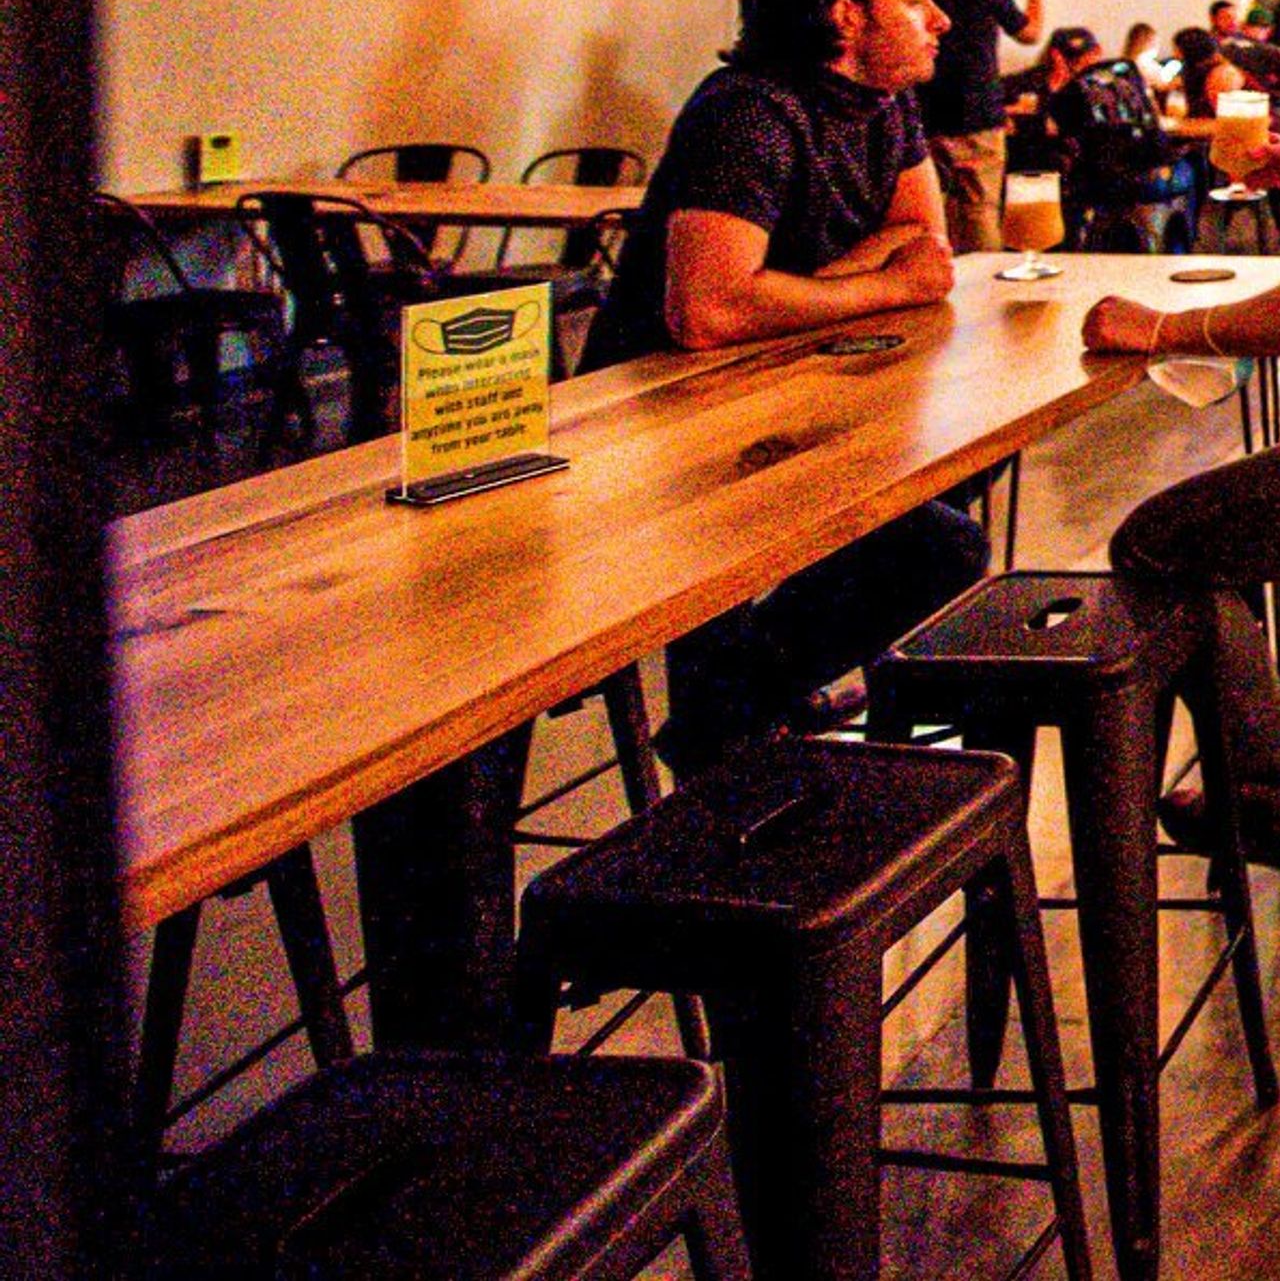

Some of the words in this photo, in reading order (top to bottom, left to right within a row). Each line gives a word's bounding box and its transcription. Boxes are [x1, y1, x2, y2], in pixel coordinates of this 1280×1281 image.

[434, 400, 463, 416] with
[467, 390, 498, 409] staff
[502, 387, 523, 401] and
[466, 415, 487, 429] you
[431, 439, 461, 454] from
[463, 432, 492, 449] your
